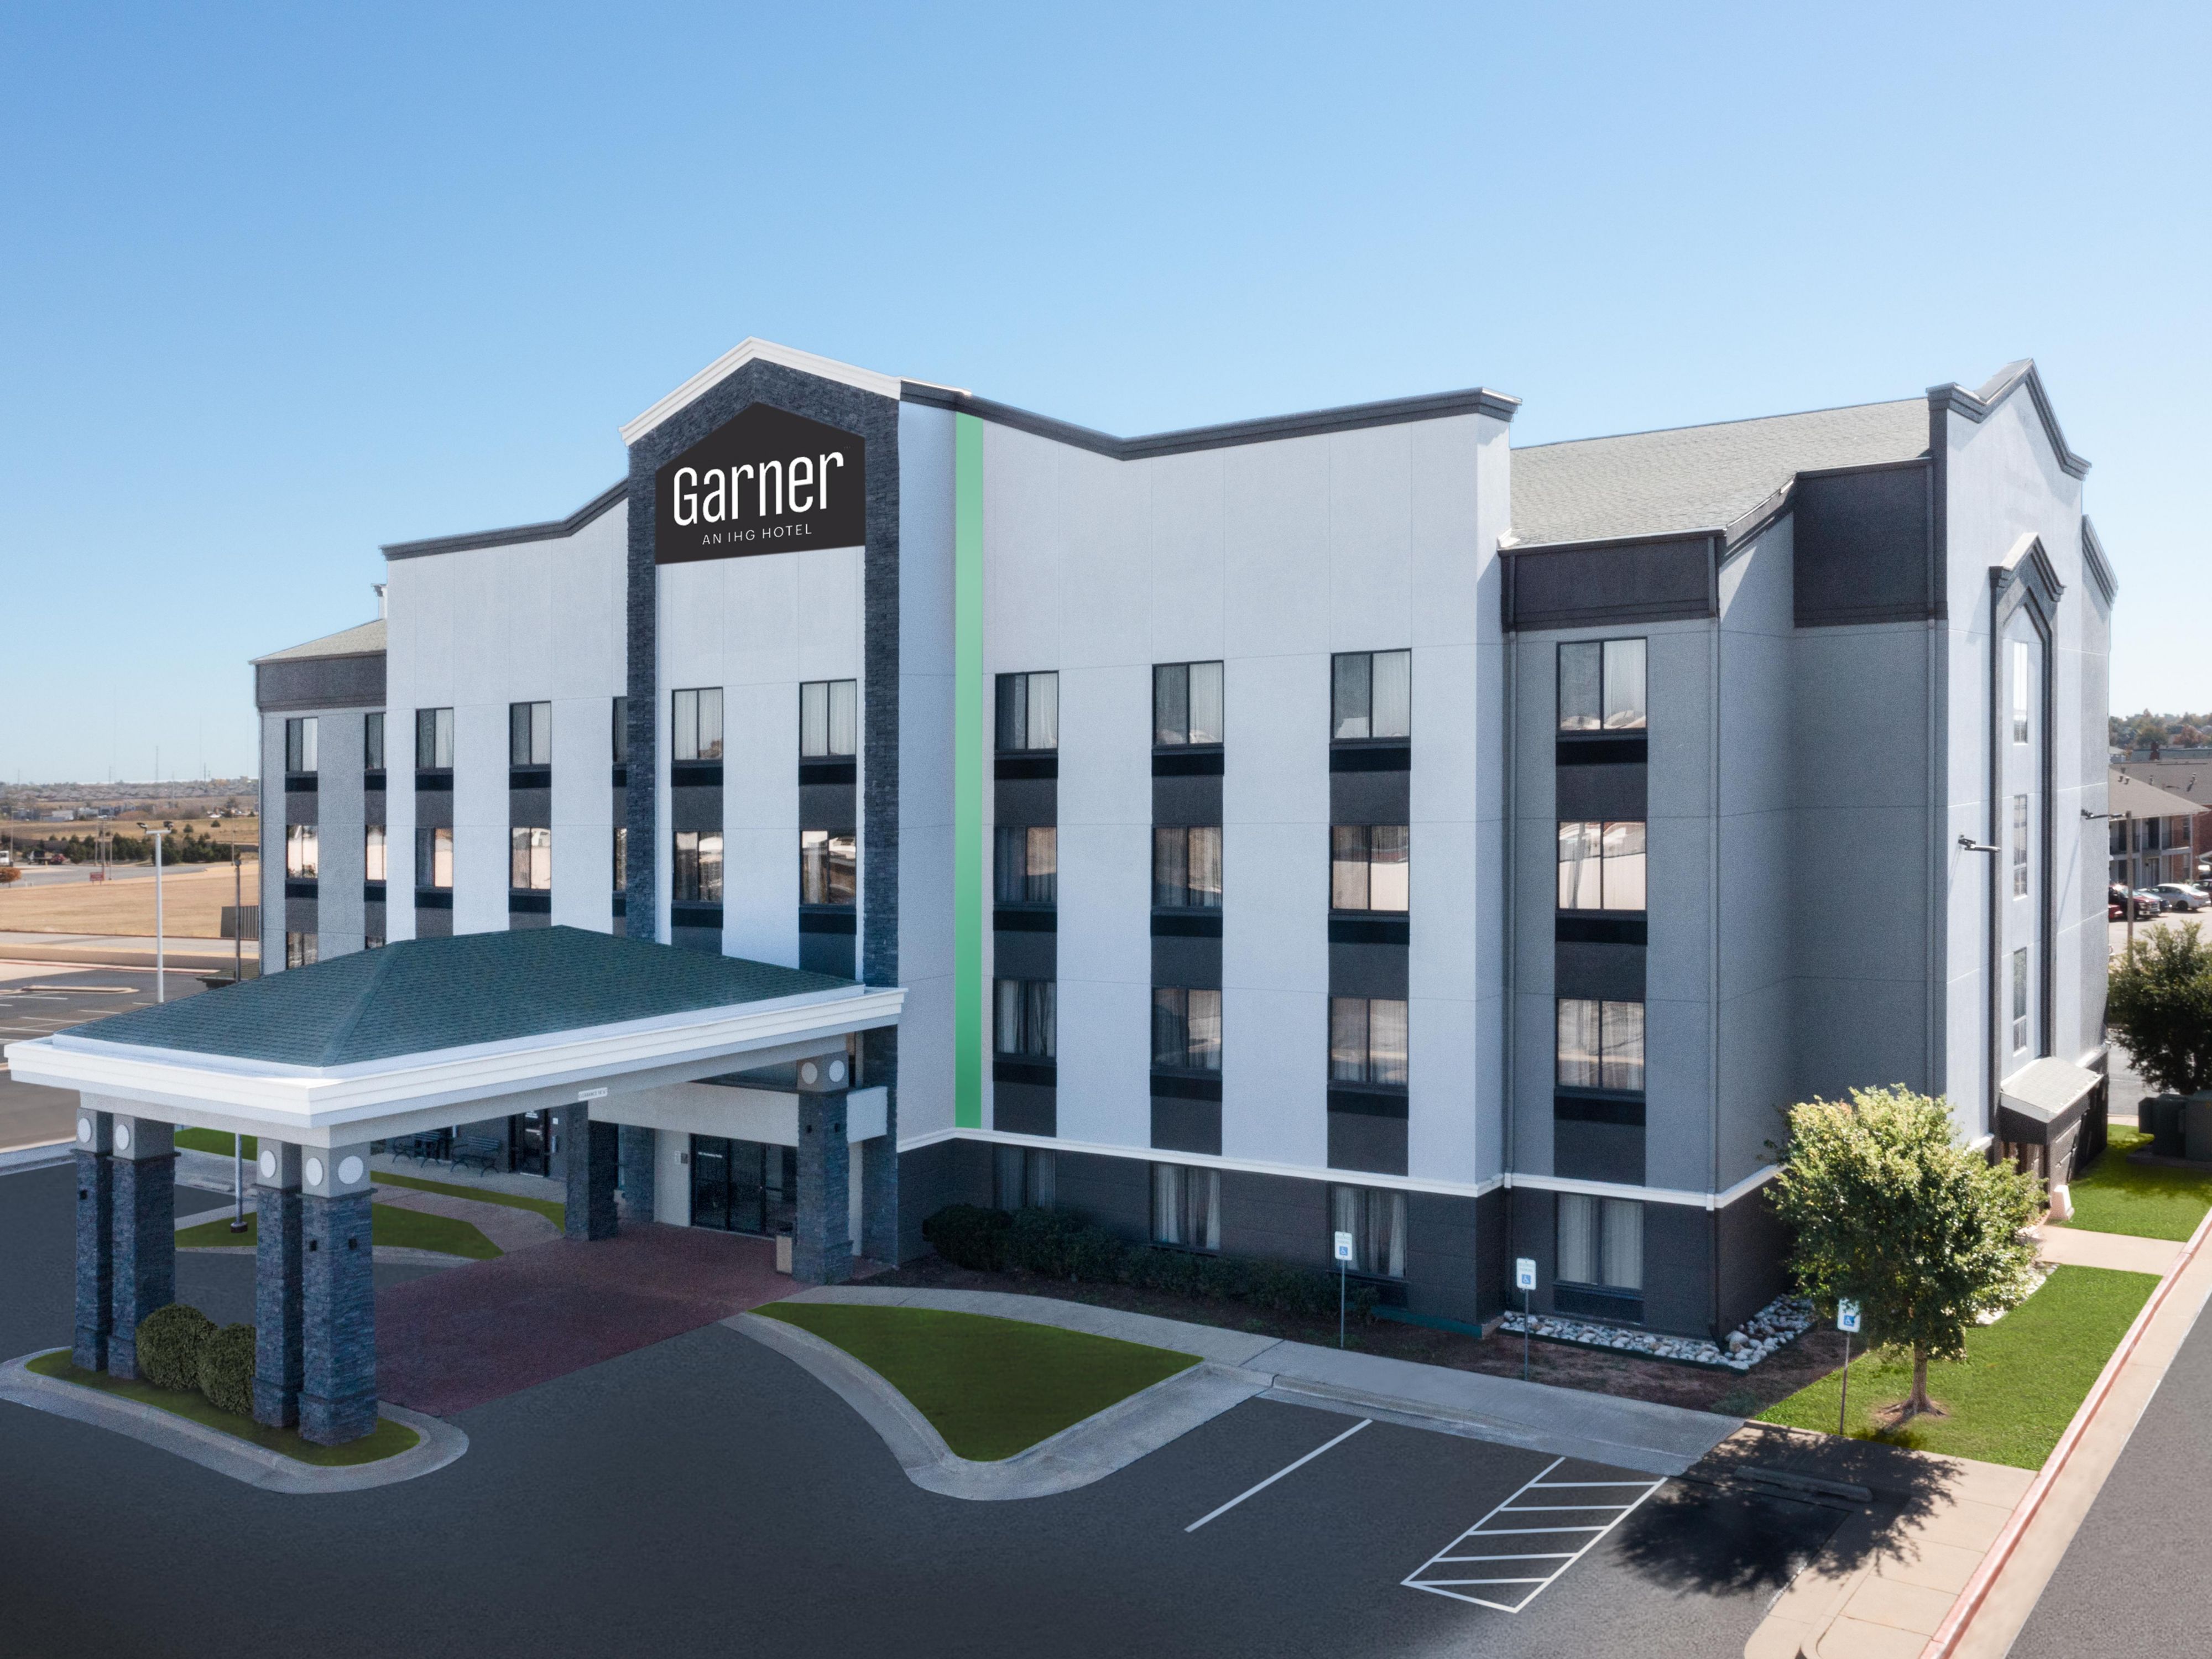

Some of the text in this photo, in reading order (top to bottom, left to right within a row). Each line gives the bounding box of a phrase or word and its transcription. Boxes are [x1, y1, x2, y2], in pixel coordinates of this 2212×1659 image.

[674, 451, 844, 526] Garner
[702, 523, 812, 545] AN IHG HOTEL
